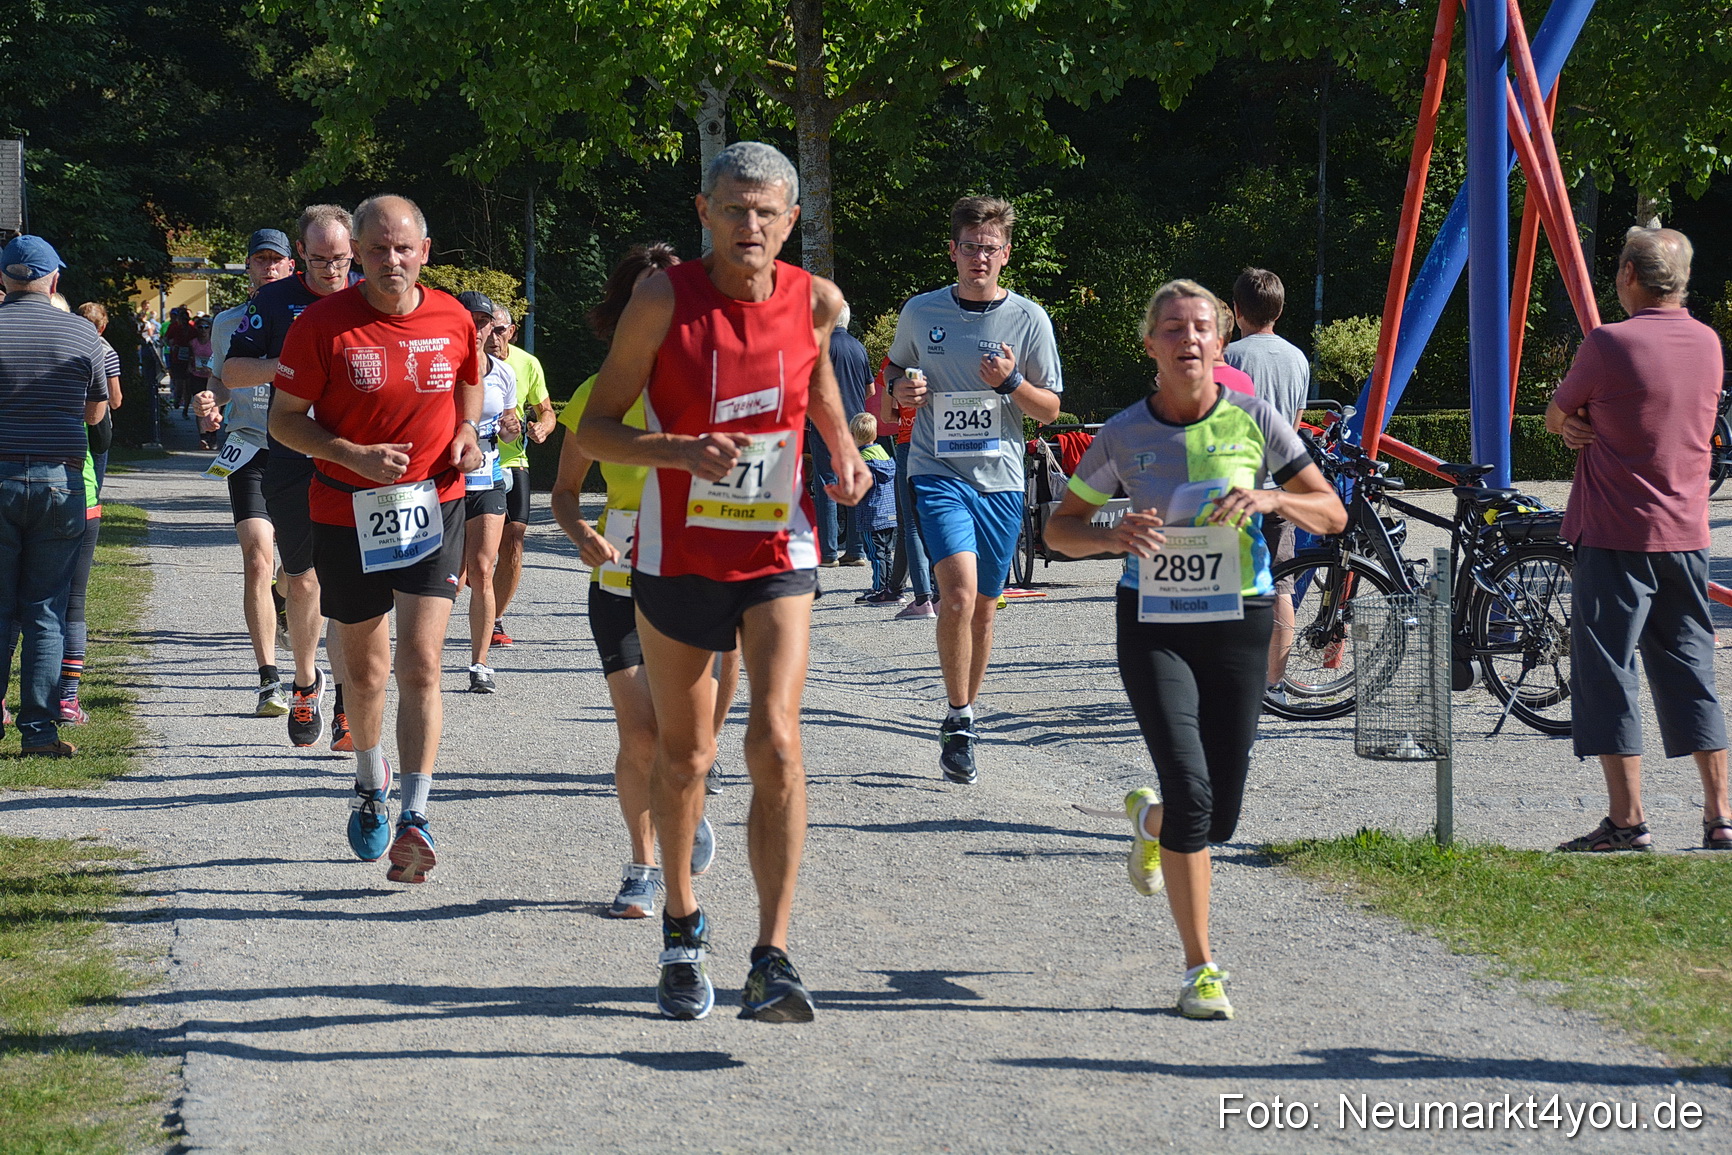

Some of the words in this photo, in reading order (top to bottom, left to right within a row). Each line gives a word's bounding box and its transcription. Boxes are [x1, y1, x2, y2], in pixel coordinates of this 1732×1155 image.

[399, 340, 409, 348] 11.
[409, 338, 451, 347] NEUMARKTER
[409, 344, 444, 353] STADTLAUF
[352, 353, 380, 361] IMMER
[351, 360, 382, 368] WIEDER
[355, 367, 381, 378] NEU
[355, 377, 382, 386] MARKT
[252, 386, 269, 397] 19.
[952, 397, 982, 406] BOCK
[944, 409, 992, 430] 2343
[949, 440, 988, 451] Christoph
[713, 460, 764, 489] 71
[377, 491, 414, 505] BOCK
[720, 504, 756, 519] Franz
[369, 505, 430, 537] 2370
[392, 545, 420, 560] Josef
[1153, 552, 1223, 582] 2897
[1170, 599, 1208, 611] Nicola
